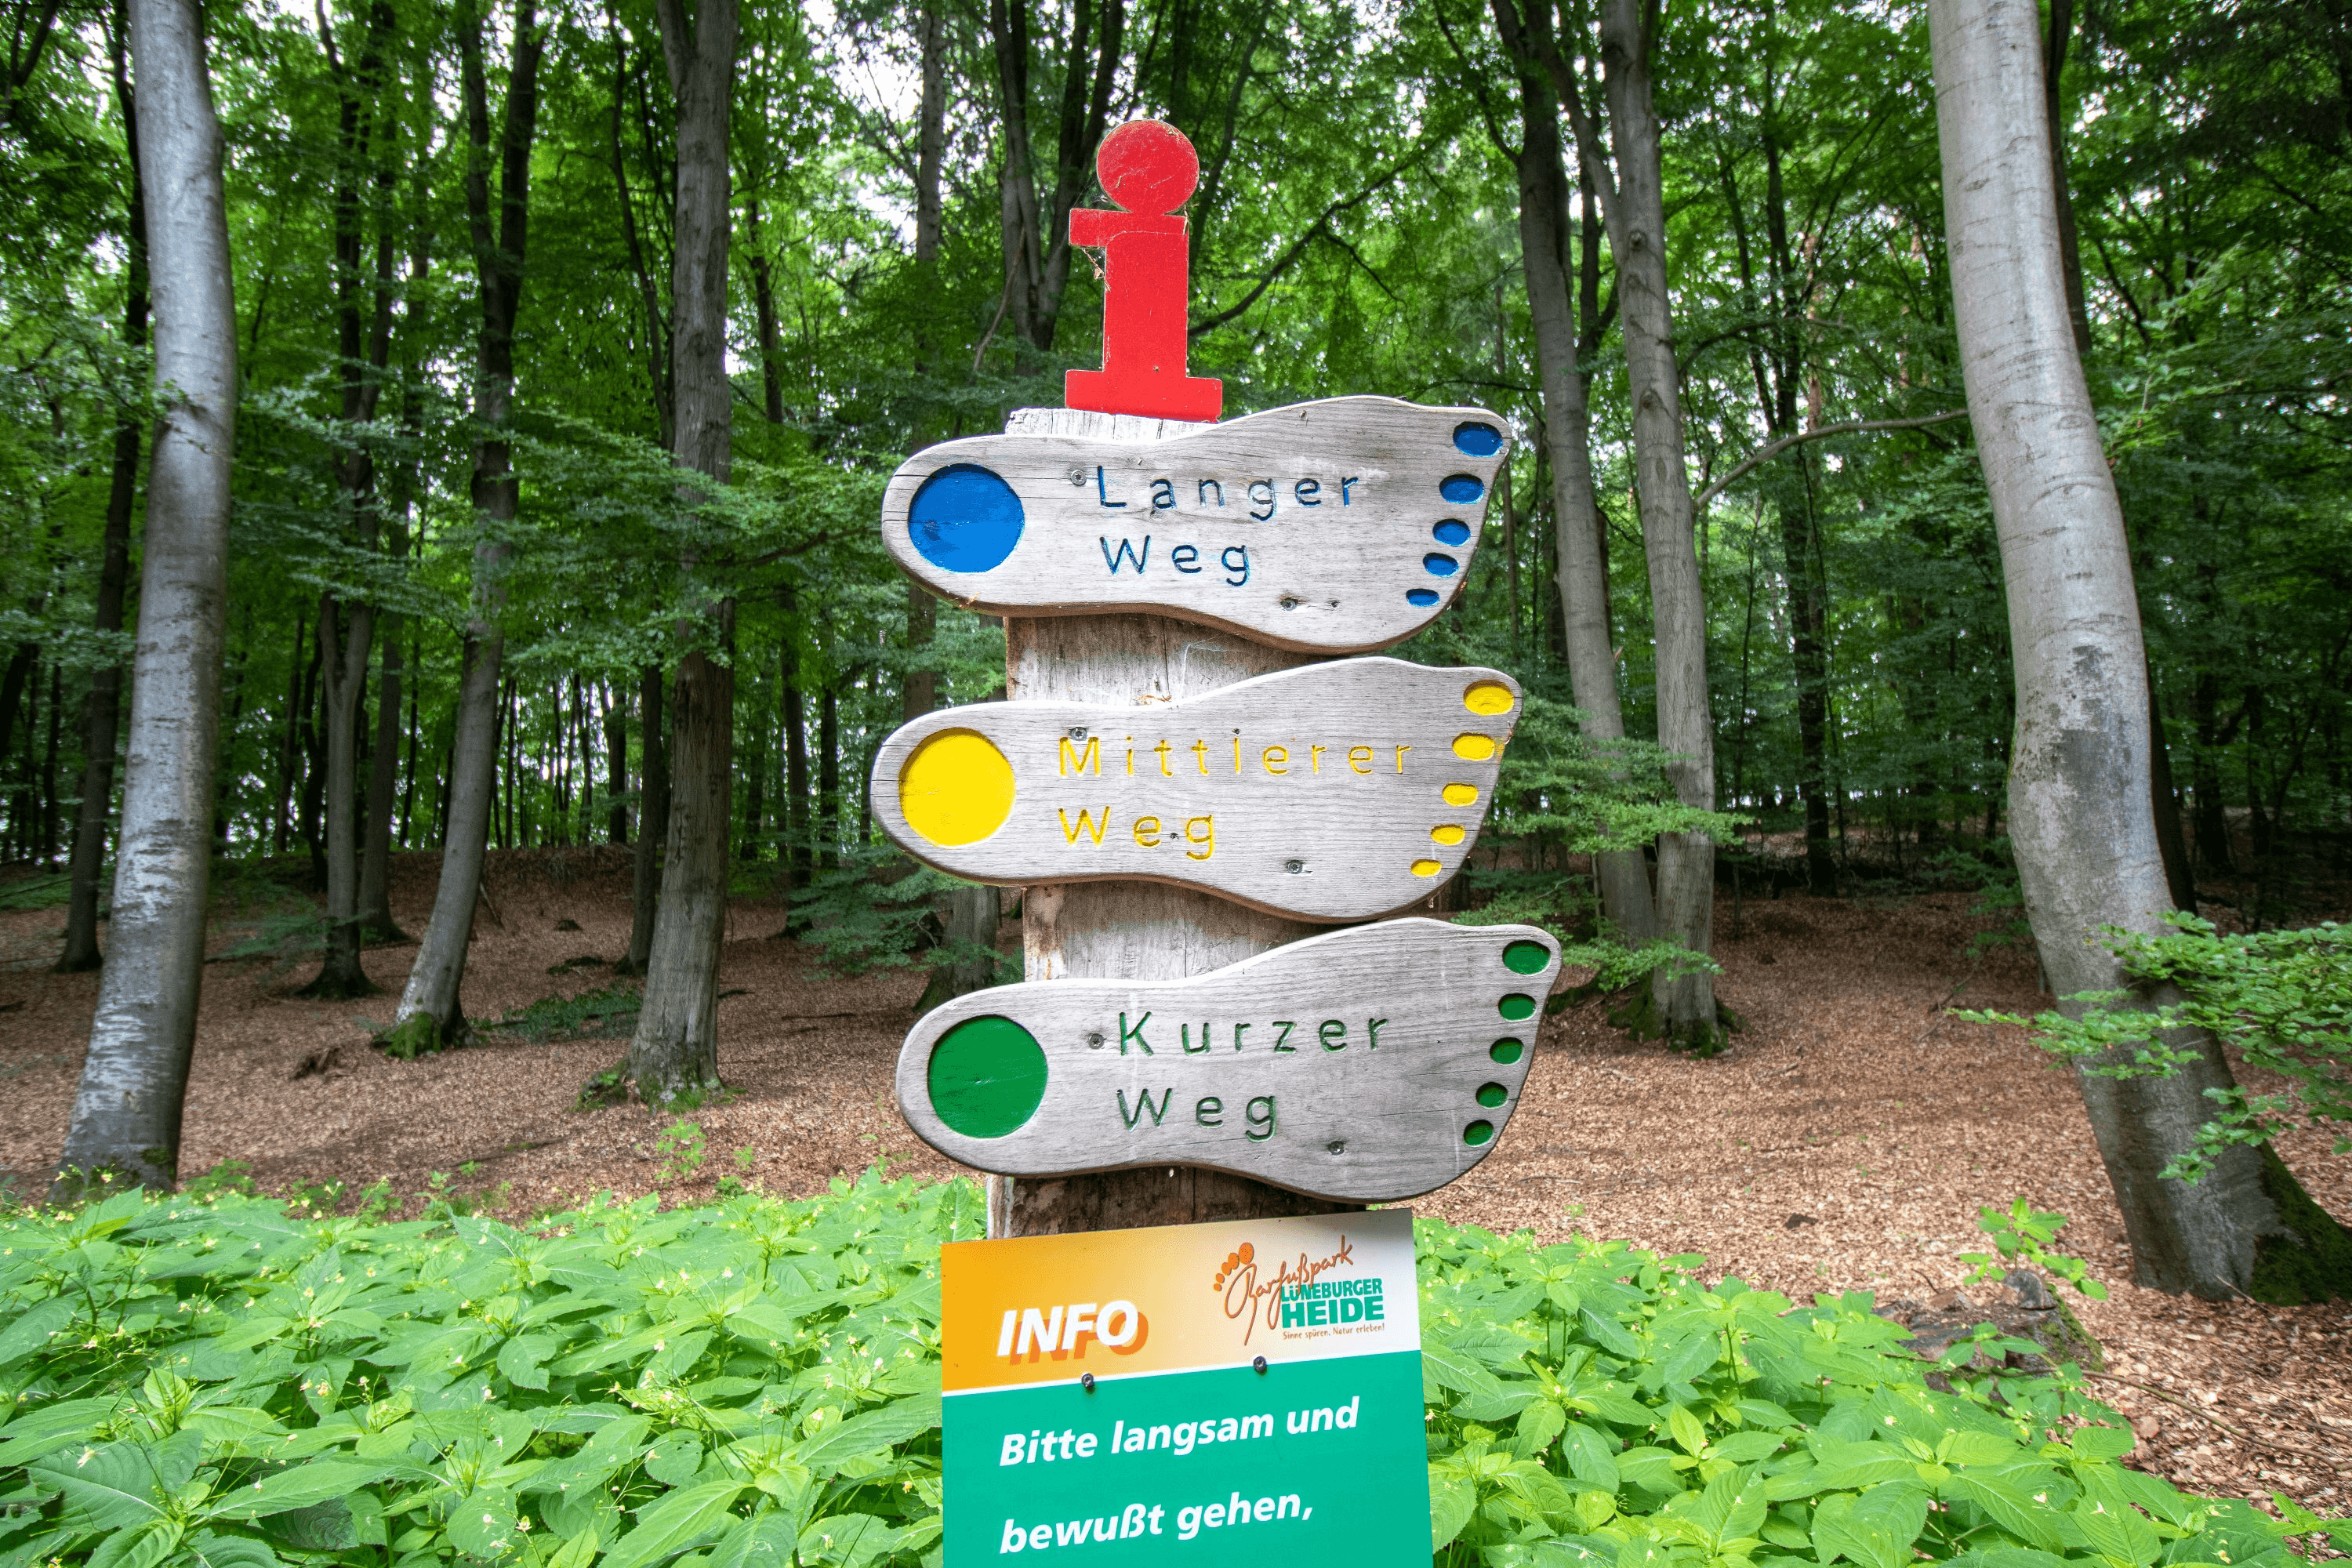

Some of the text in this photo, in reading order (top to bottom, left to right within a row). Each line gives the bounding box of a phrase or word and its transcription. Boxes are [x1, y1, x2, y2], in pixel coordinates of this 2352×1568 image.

[1097, 465, 1359, 521] Langer
[1099, 535, 1250, 586] Weg
[1058, 736, 1413, 777] Mittlerer
[1058, 805, 1214, 860] Weg
[1119, 1011, 1389, 1057] Kurzer
[1116, 1087, 1277, 1142] Weg
[1225, 1234, 1354, 1346] Barfußpark
[1280, 1278, 1383, 1302] LÜNEBURGER
[1281, 1295, 1385, 1329] HEIDE
[996, 1300, 1140, 1358] INFO
[1283, 1330, 1302, 1340] Sinne
[1333, 1325, 1353, 1335] Natur
[1356, 1322, 1385, 1334] erleben!
[999, 1396, 1360, 1467] Bitte langsam und
[999, 1492, 1313, 1555] bewußt gehen,
